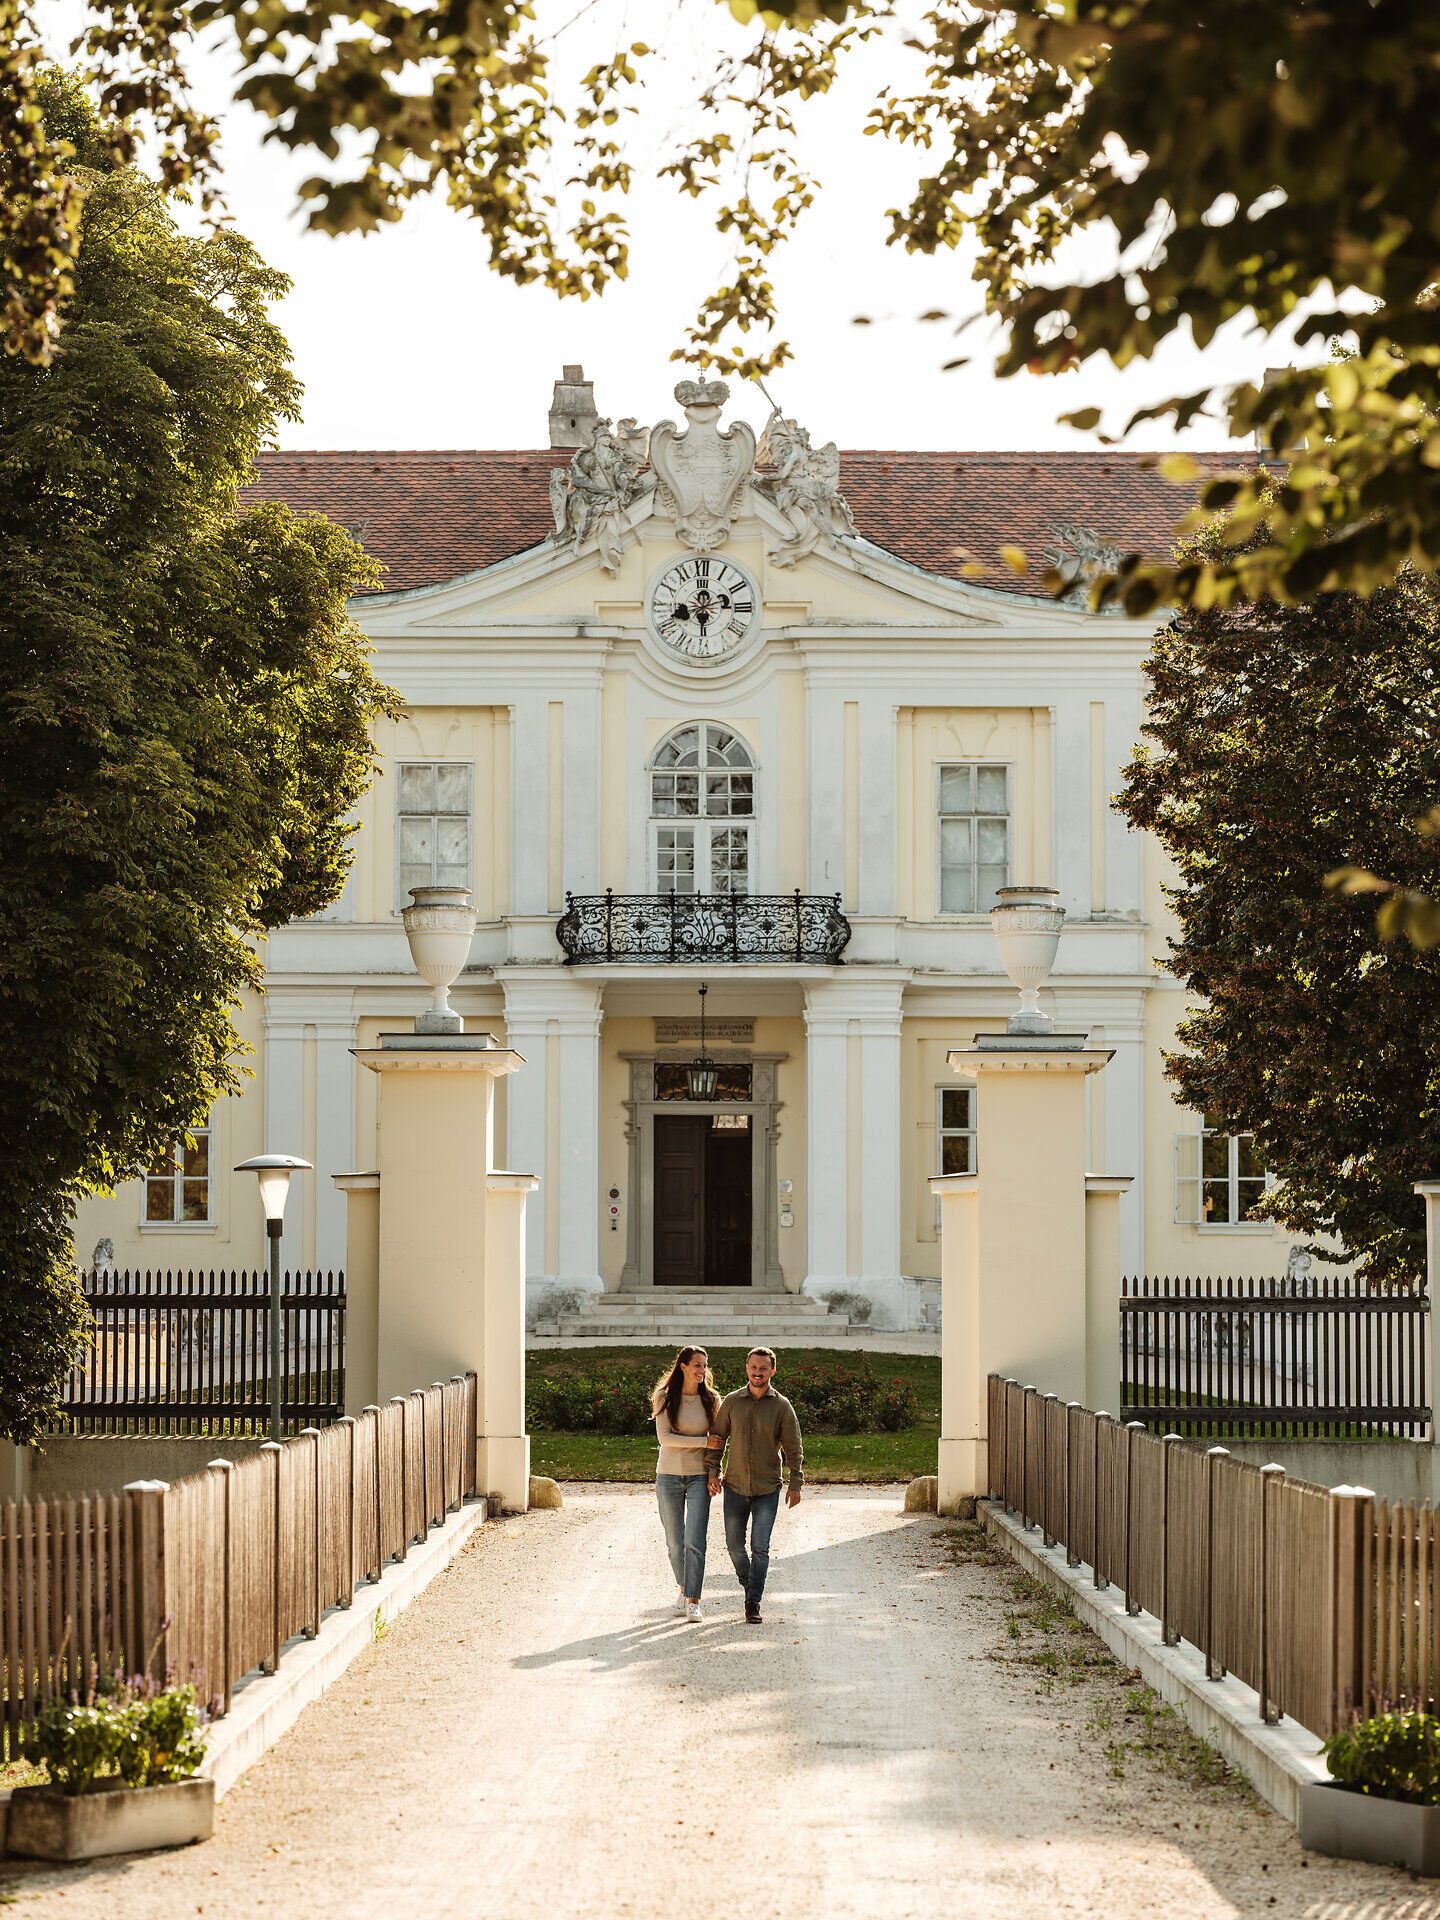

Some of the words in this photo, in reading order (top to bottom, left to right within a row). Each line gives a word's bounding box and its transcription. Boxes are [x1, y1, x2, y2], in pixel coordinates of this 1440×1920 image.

[693, 560, 710, 577] XII
[717, 564, 728, 581] I
[728, 580, 747, 595] II
[734, 601, 752, 614] III
